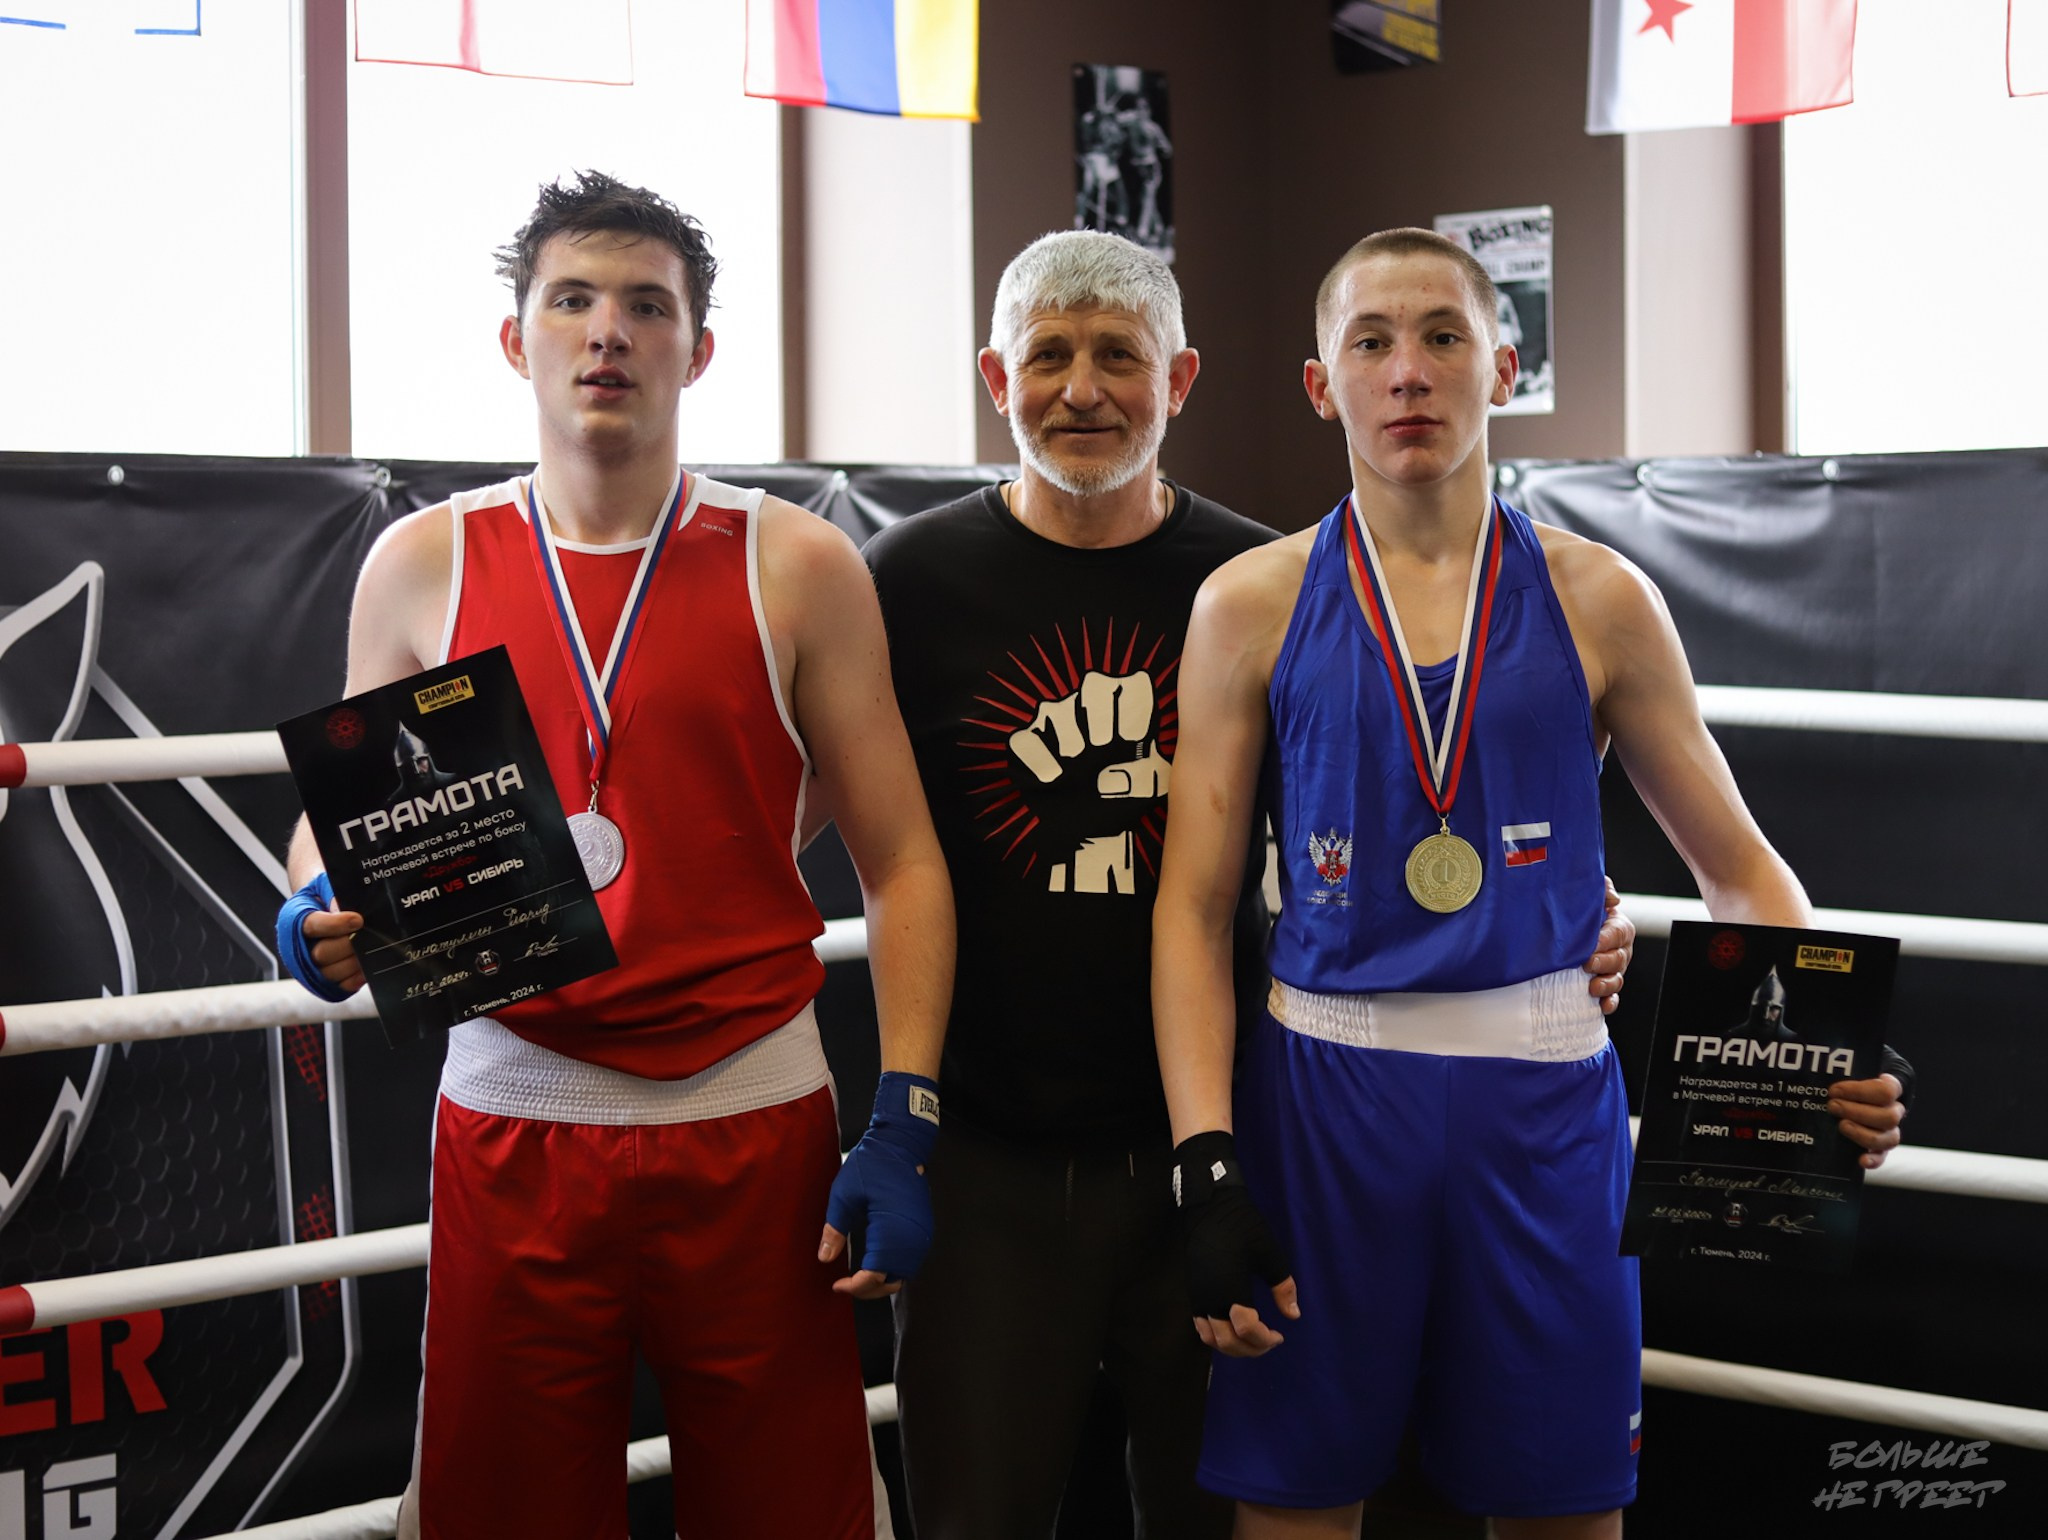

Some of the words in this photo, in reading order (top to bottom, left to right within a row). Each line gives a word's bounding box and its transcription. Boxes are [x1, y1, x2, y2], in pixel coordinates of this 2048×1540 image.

[701, 522, 734, 537] BOXING
[338, 763, 525, 850] ГРАМОТА
[361, 834, 443, 869] Награждается
[446, 832, 459, 842] за
[460, 822, 471, 835] 2
[473, 809, 516, 830] место
[363, 876, 371, 885] в
[372, 854, 430, 881] Матчевой
[431, 840, 477, 862] встрече
[479, 833, 493, 844] по
[494, 820, 527, 838] боксу
[401, 886, 441, 908] УРАЛ
[467, 857, 525, 885] СИБИРЬ
[510, 984, 535, 1001] 2024
[1673, 1034, 1855, 1077] ГРАМОТА
[1679, 1075, 1758, 1091] Награждается
[1760, 1083, 1774, 1092] за
[1777, 1081, 1784, 1092] 1
[1787, 1085, 1829, 1098] место
[1672, 1092, 1680, 1100] в
[1681, 1089, 1736, 1103] Матчевой
[1738, 1095, 1782, 1108] встрече
[1785, 1099, 1800, 1109] по
[1801, 1099, 1829, 1112] бокс
[1692, 1124, 1730, 1137] УРАЛ
[1757, 1129, 1815, 1145] СИБИРЬ
[1738, 1250, 1762, 1260] 2024
